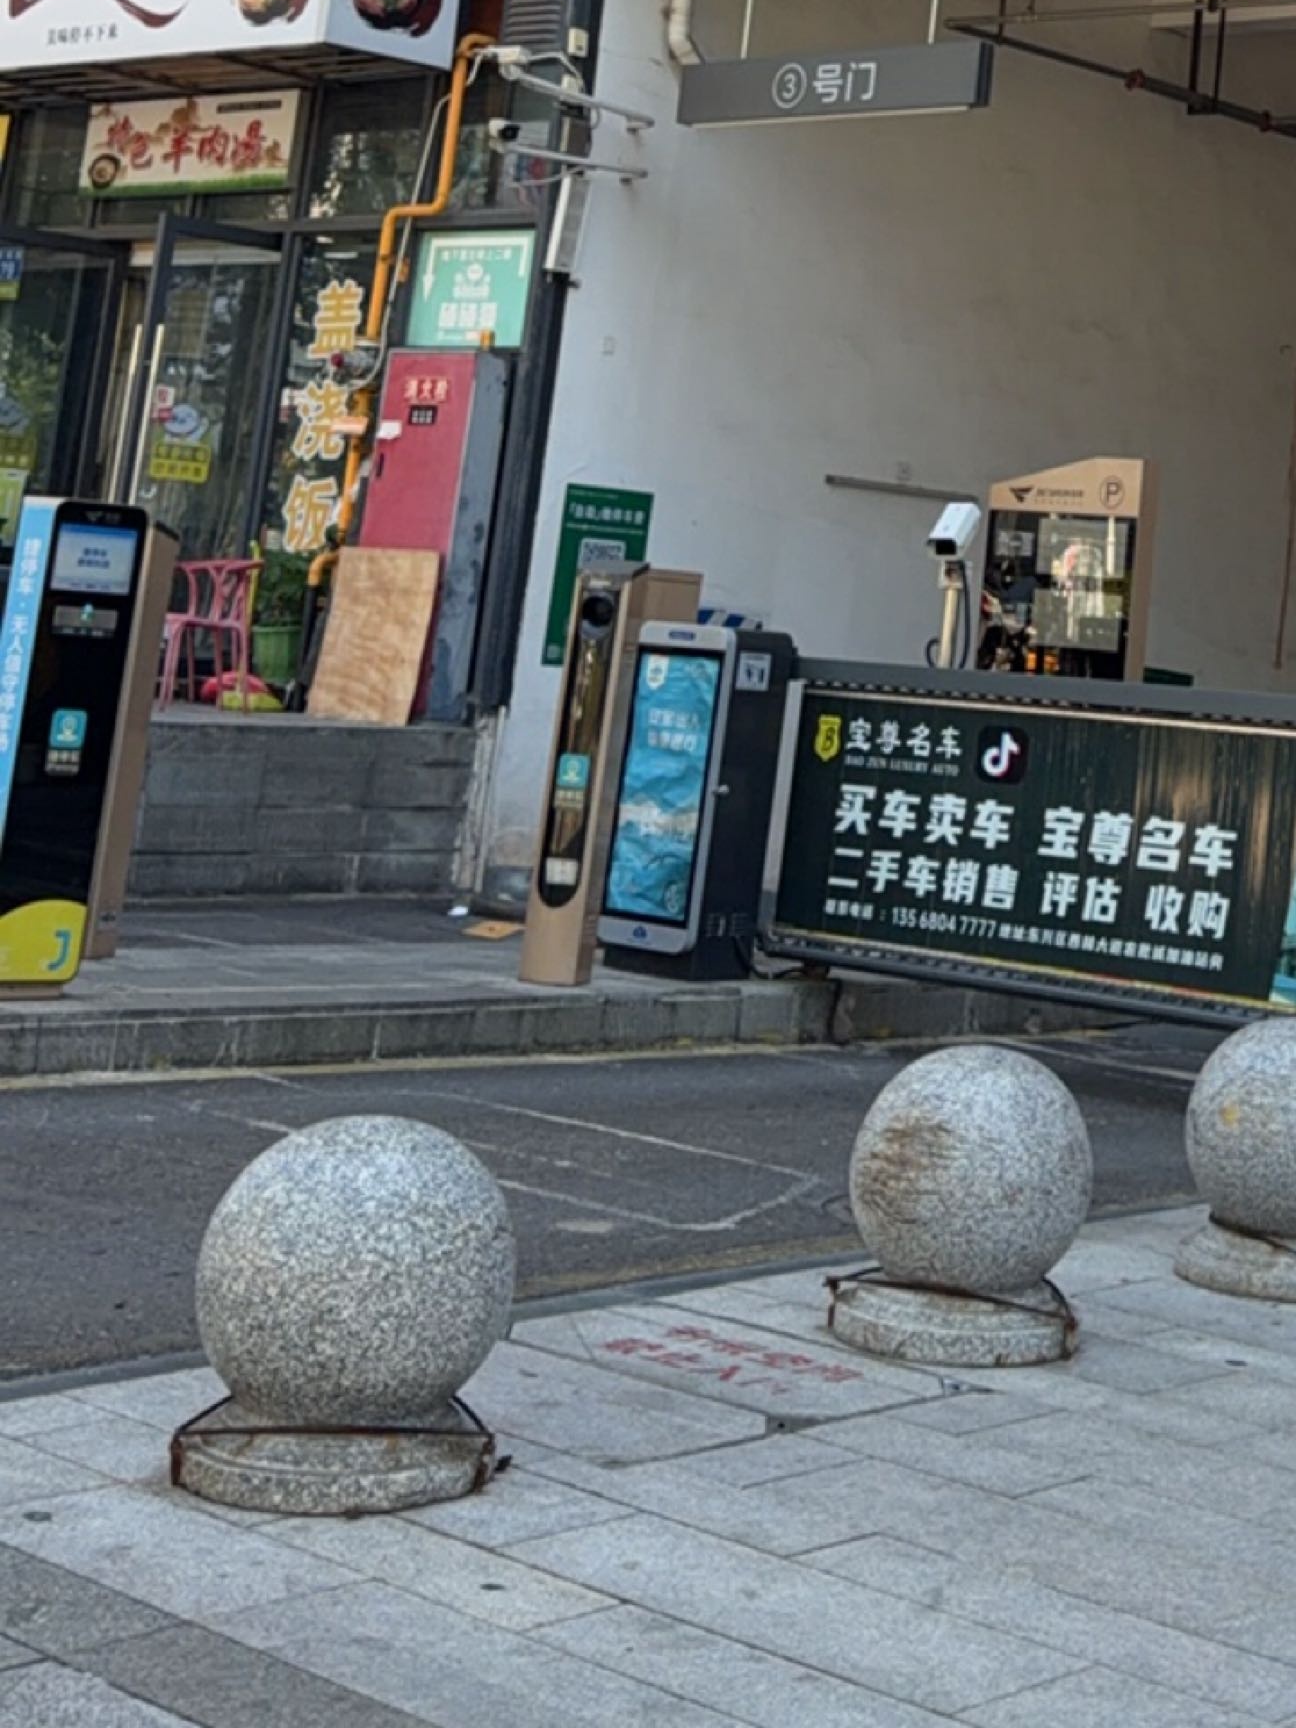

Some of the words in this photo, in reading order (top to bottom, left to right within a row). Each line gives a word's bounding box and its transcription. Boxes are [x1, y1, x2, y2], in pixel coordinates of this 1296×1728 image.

[846, 717, 962, 760] 宝尊名车
[834, 783, 1015, 851] 买车卖车
[1037, 806, 1239, 878] 宝尊名车
[827, 846, 1021, 912] 二手车销售
[1038, 870, 1123, 925] 评估
[1143, 884, 1231, 940] 收购
[892, 906, 916, 928] 135
[959, 915, 998, 939] 7777
